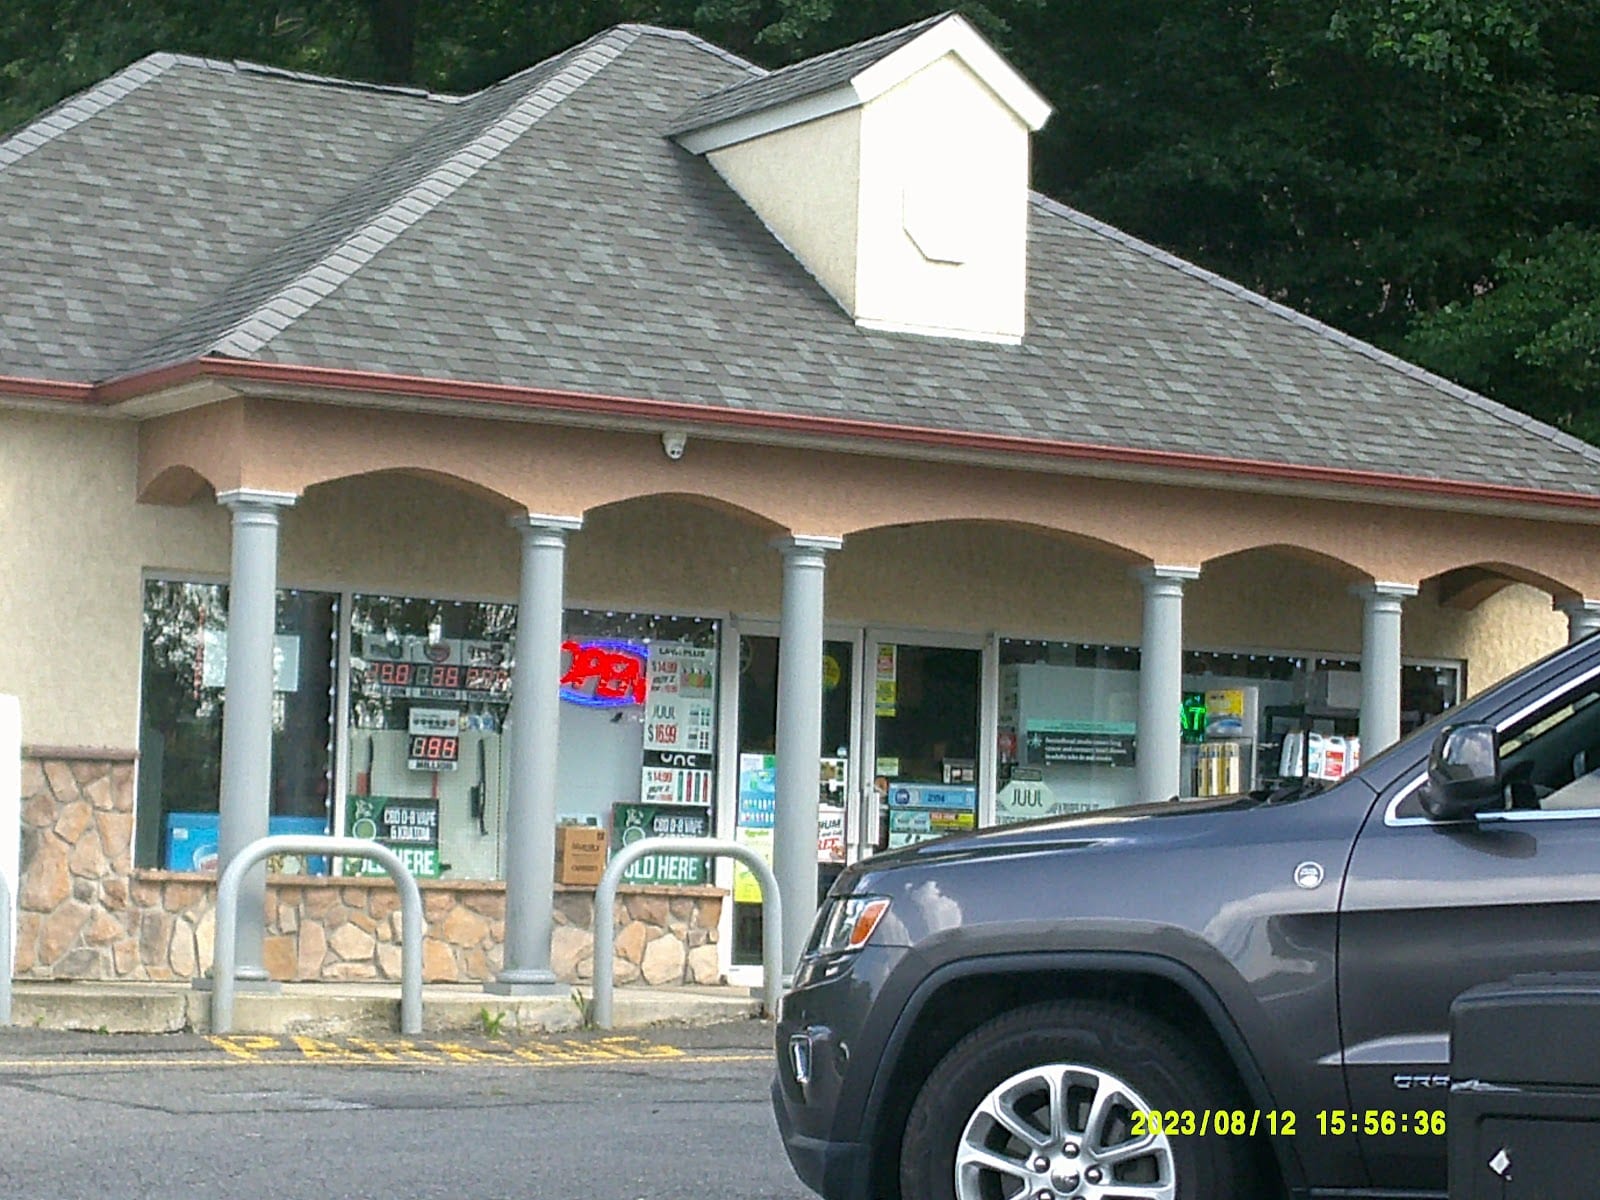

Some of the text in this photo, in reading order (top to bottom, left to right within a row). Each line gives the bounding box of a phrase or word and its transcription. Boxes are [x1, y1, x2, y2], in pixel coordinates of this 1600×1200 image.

[1011, 788, 1043, 807] JUUL
[623, 855, 699, 880] OLD HERE
